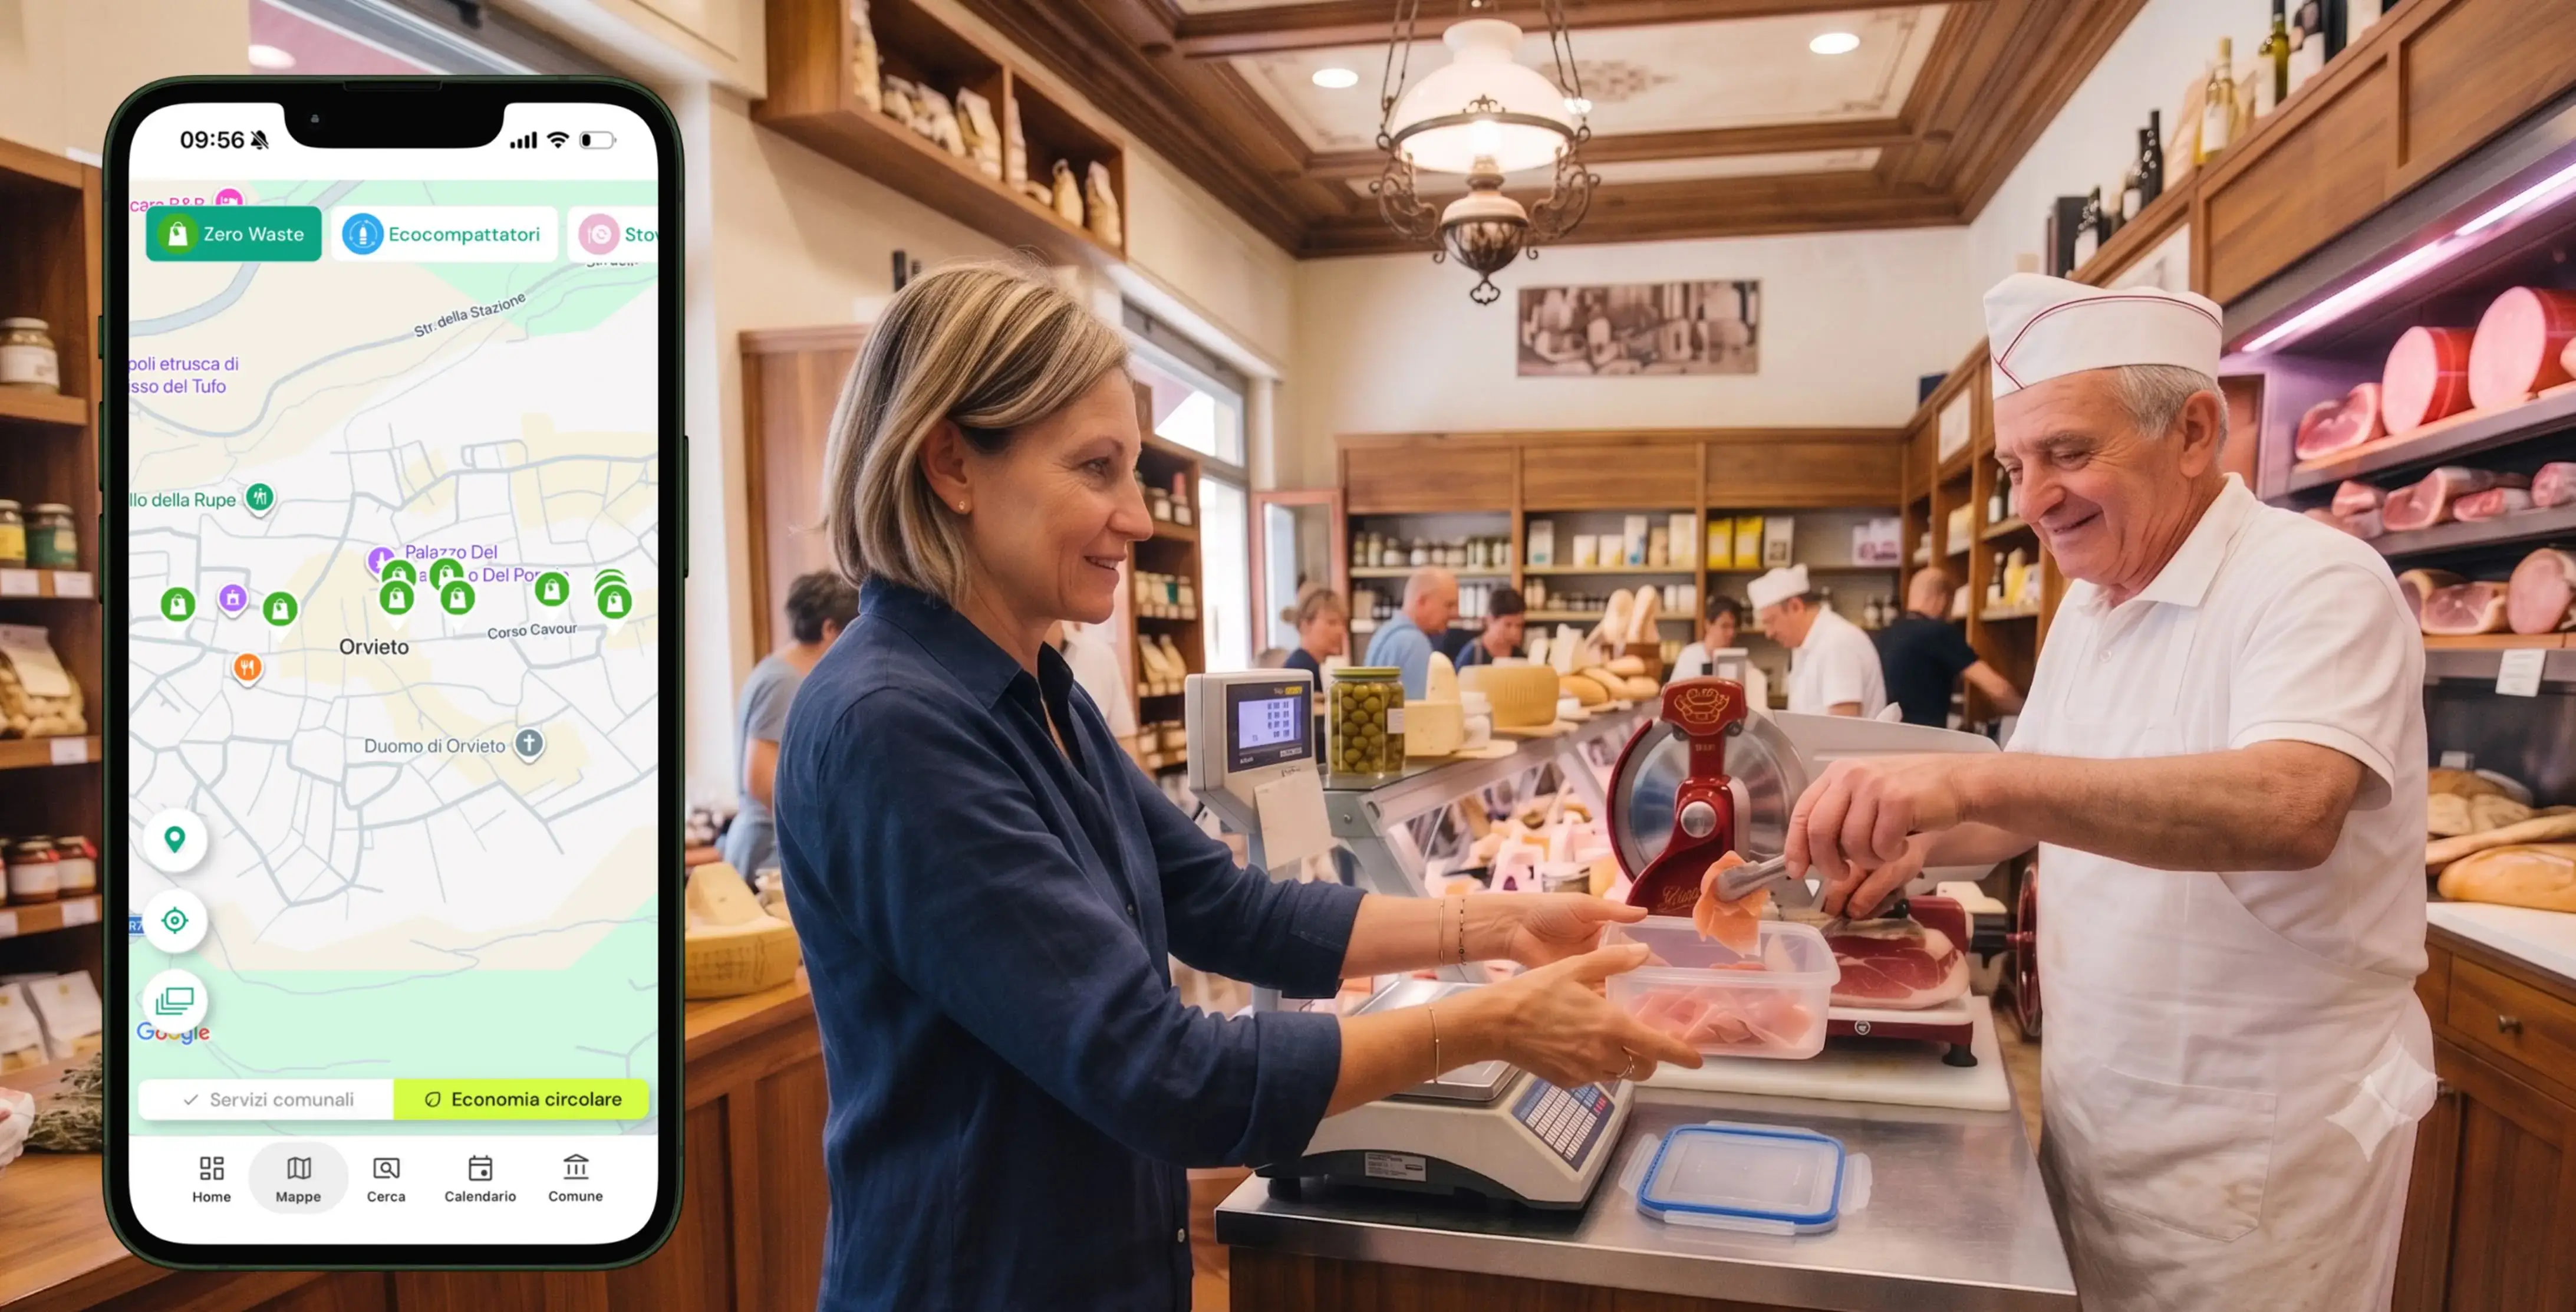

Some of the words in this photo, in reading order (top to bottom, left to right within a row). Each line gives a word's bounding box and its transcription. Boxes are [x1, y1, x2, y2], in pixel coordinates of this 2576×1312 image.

[180, 131, 245, 149] 09:56
[204, 226, 243, 241] Zero
[248, 226, 304, 241] Waste
[389, 226, 540, 245] Ecocompattatori
[414, 324, 437, 337] Str.
[437, 310, 468, 328] della
[470, 294, 526, 318] Stazione
[160, 357, 220, 371] etrusca
[224, 357, 239, 371] di
[163, 379, 187, 393] del
[192, 379, 226, 393] Tufo
[151, 492, 190, 507] della
[195, 492, 236, 510] Rupe
[406, 545, 467, 559] Palazzo
[472, 545, 498, 559] Del
[483, 568, 509, 582] Del
[487, 627, 528, 640] Corso
[530, 623, 578, 636] Cavour
[340, 638, 409, 655] Orvieto
[364, 738, 423, 754] Duomo
[427, 738, 442, 754] di
[446, 738, 506, 754] Orvieto
[210, 1091, 267, 1107] Servizi
[273, 1091, 354, 1107] comunali
[452, 1091, 539, 1107] Economia
[545, 1091, 622, 1107] circolare
[193, 1191, 231, 1202] Home
[276, 1191, 321, 1205] Mappe
[367, 1191, 406, 1202] Cerca
[444, 1191, 516, 1202] Calendario
[548, 1191, 603, 1202] Comune
